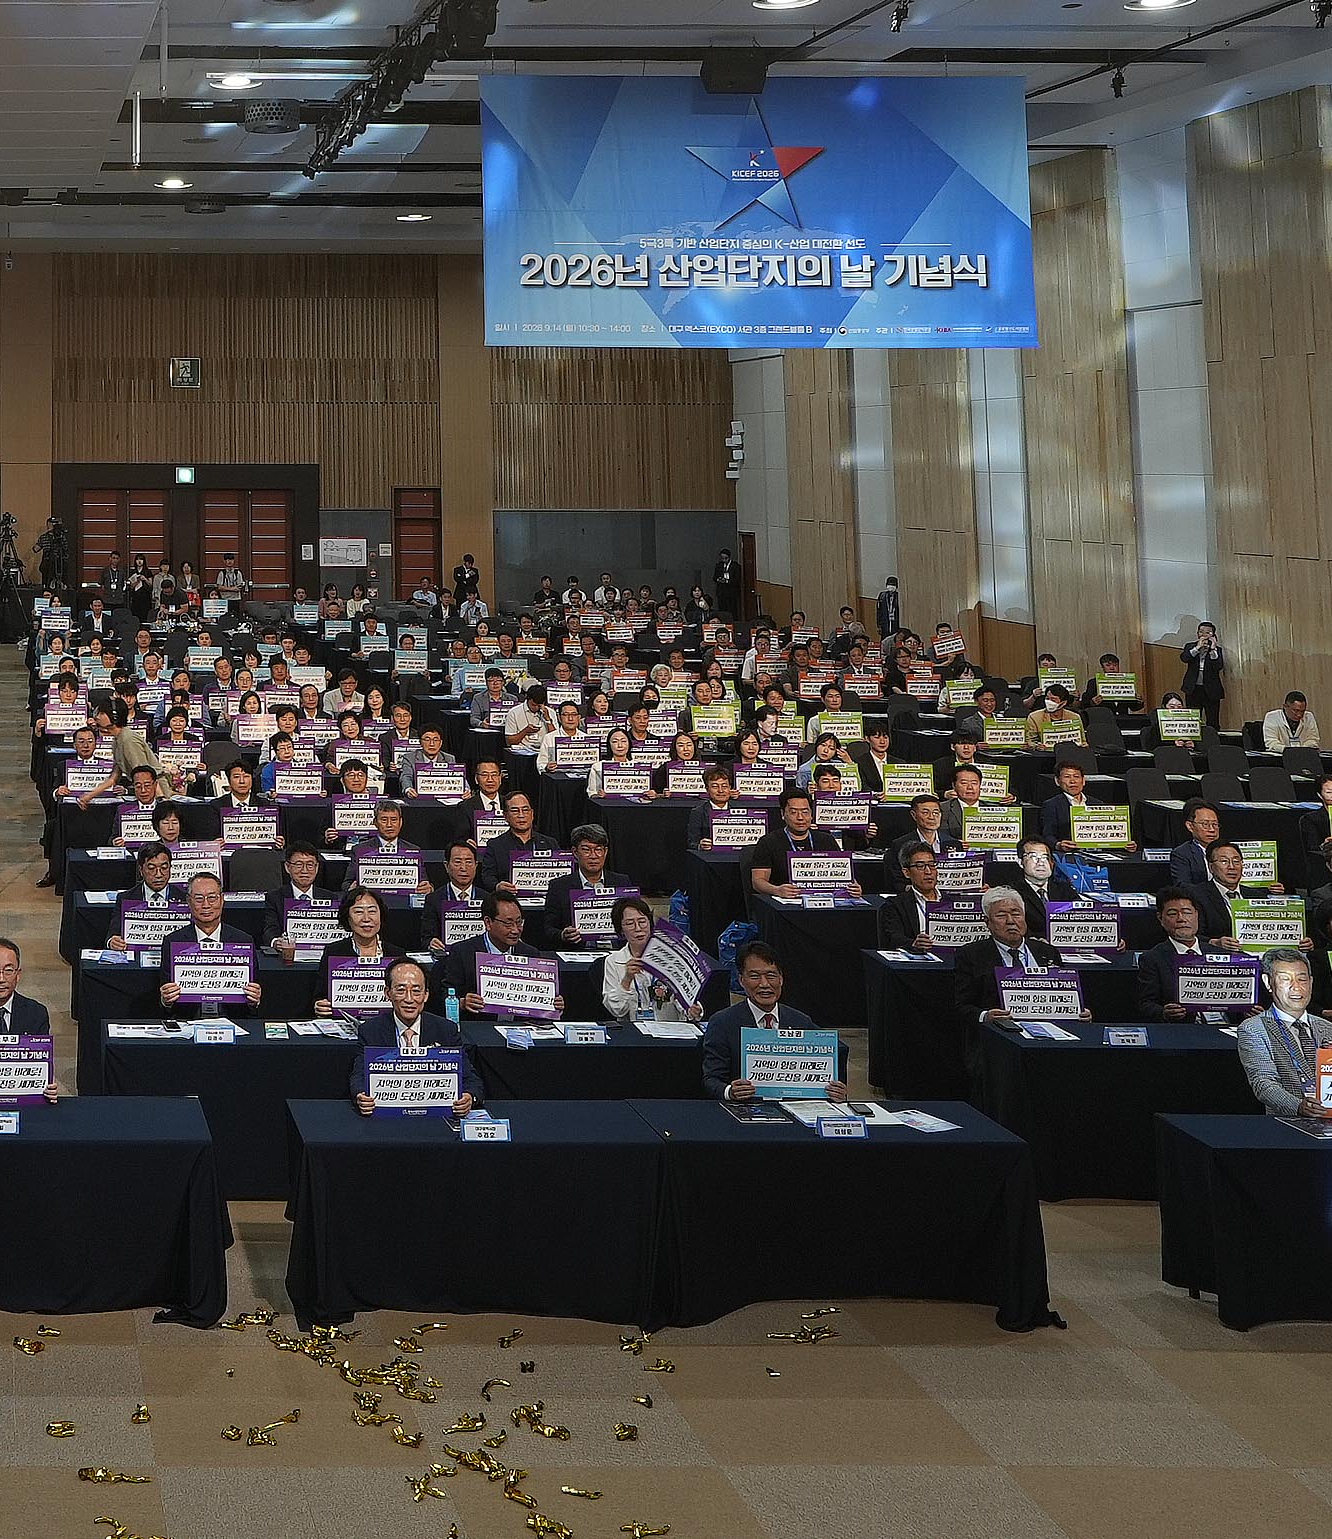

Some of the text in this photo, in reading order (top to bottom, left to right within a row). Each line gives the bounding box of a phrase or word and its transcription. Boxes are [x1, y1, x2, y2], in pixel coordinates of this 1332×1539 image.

[677, 239, 698, 249] 기반
[700, 239, 740, 249] 산업단지
[742, 239, 772, 249] 중심의
[775, 239, 810, 249] K-산업
[812, 239, 843, 249] 대전환
[846, 239, 866, 249] 선도
[520, 253, 987, 288] 2026년 산업단지의 날 기념식
[746, 1044, 770, 1052] 2026년
[772, 1045, 805, 1053] 산업단지의
[29, 1051, 49, 1059] 기념식
[369, 1063, 394, 1071] 2026년
[395, 1063, 428, 1071] 산업단지의
[752, 1060, 778, 1070] 지역의
[749, 1071, 775, 1080] 기업의
[376, 1079, 402, 1088] 지역의
[373, 1092, 398, 1100] 기업의
